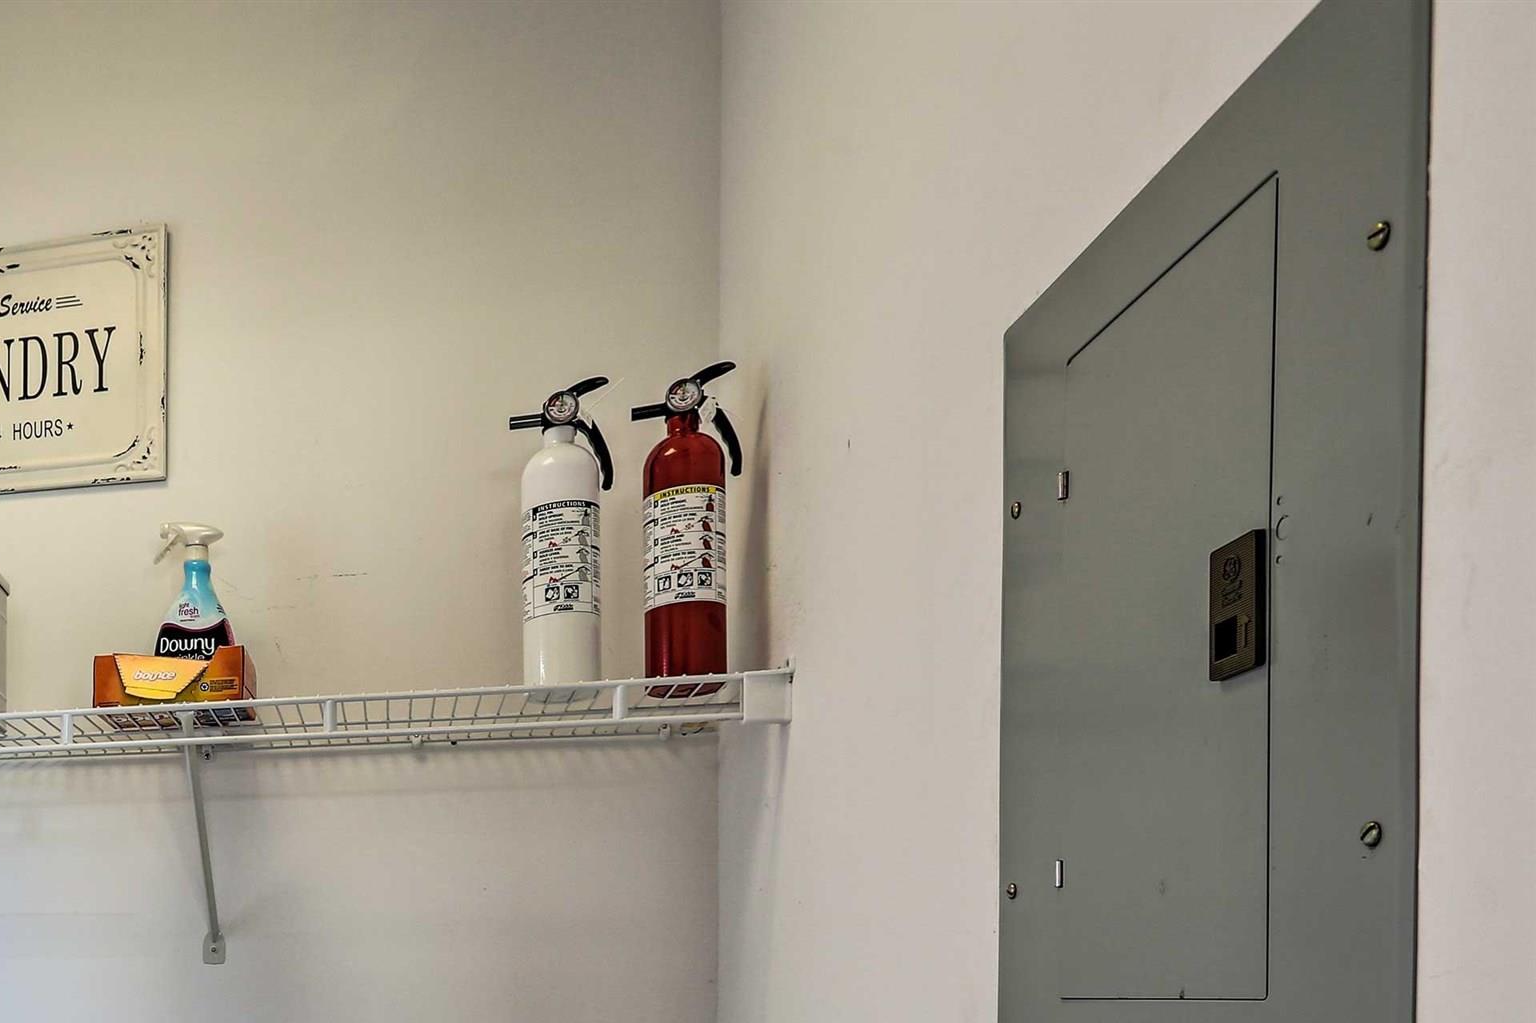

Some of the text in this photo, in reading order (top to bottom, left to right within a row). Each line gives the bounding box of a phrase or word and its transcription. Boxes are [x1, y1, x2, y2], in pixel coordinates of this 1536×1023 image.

[12, 418, 63, 441] HOURS
[659, 486, 711, 499] INSTRUCTIONS
[537, 501, 586, 511] INSTRUCTIONS
[178, 607, 199, 616] fresh
[160, 637, 215, 655] Downy
[134, 671, 176, 681] bounce
